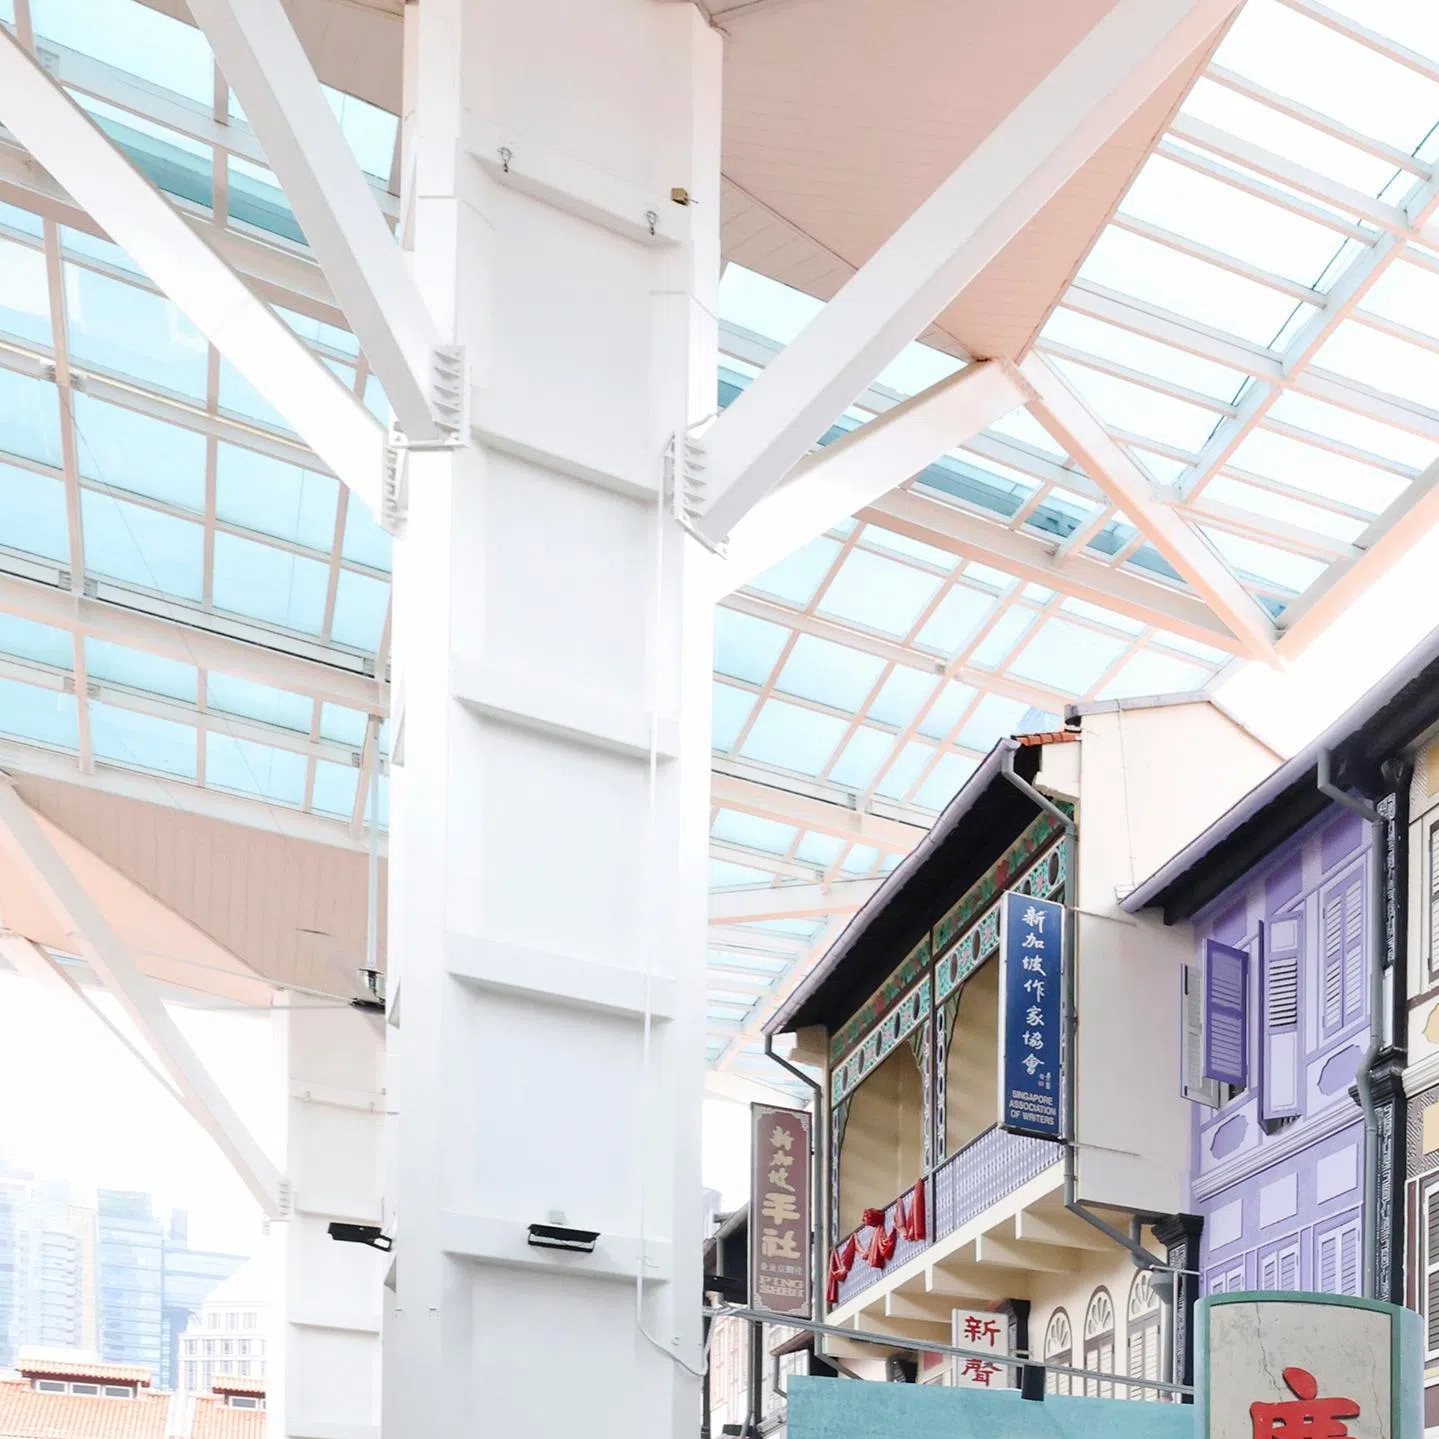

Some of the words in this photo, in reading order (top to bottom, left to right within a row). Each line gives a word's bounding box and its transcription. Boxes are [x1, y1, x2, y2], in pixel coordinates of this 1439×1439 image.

[1011, 1089, 1053, 1105] SINGAPORE
[1008, 1099, 1057, 1115] ASSOCIATION
[1010, 1109, 1022, 1118] OF
[1022, 1112, 1055, 1126] WRITERS
[759, 1275, 804, 1289] PING
